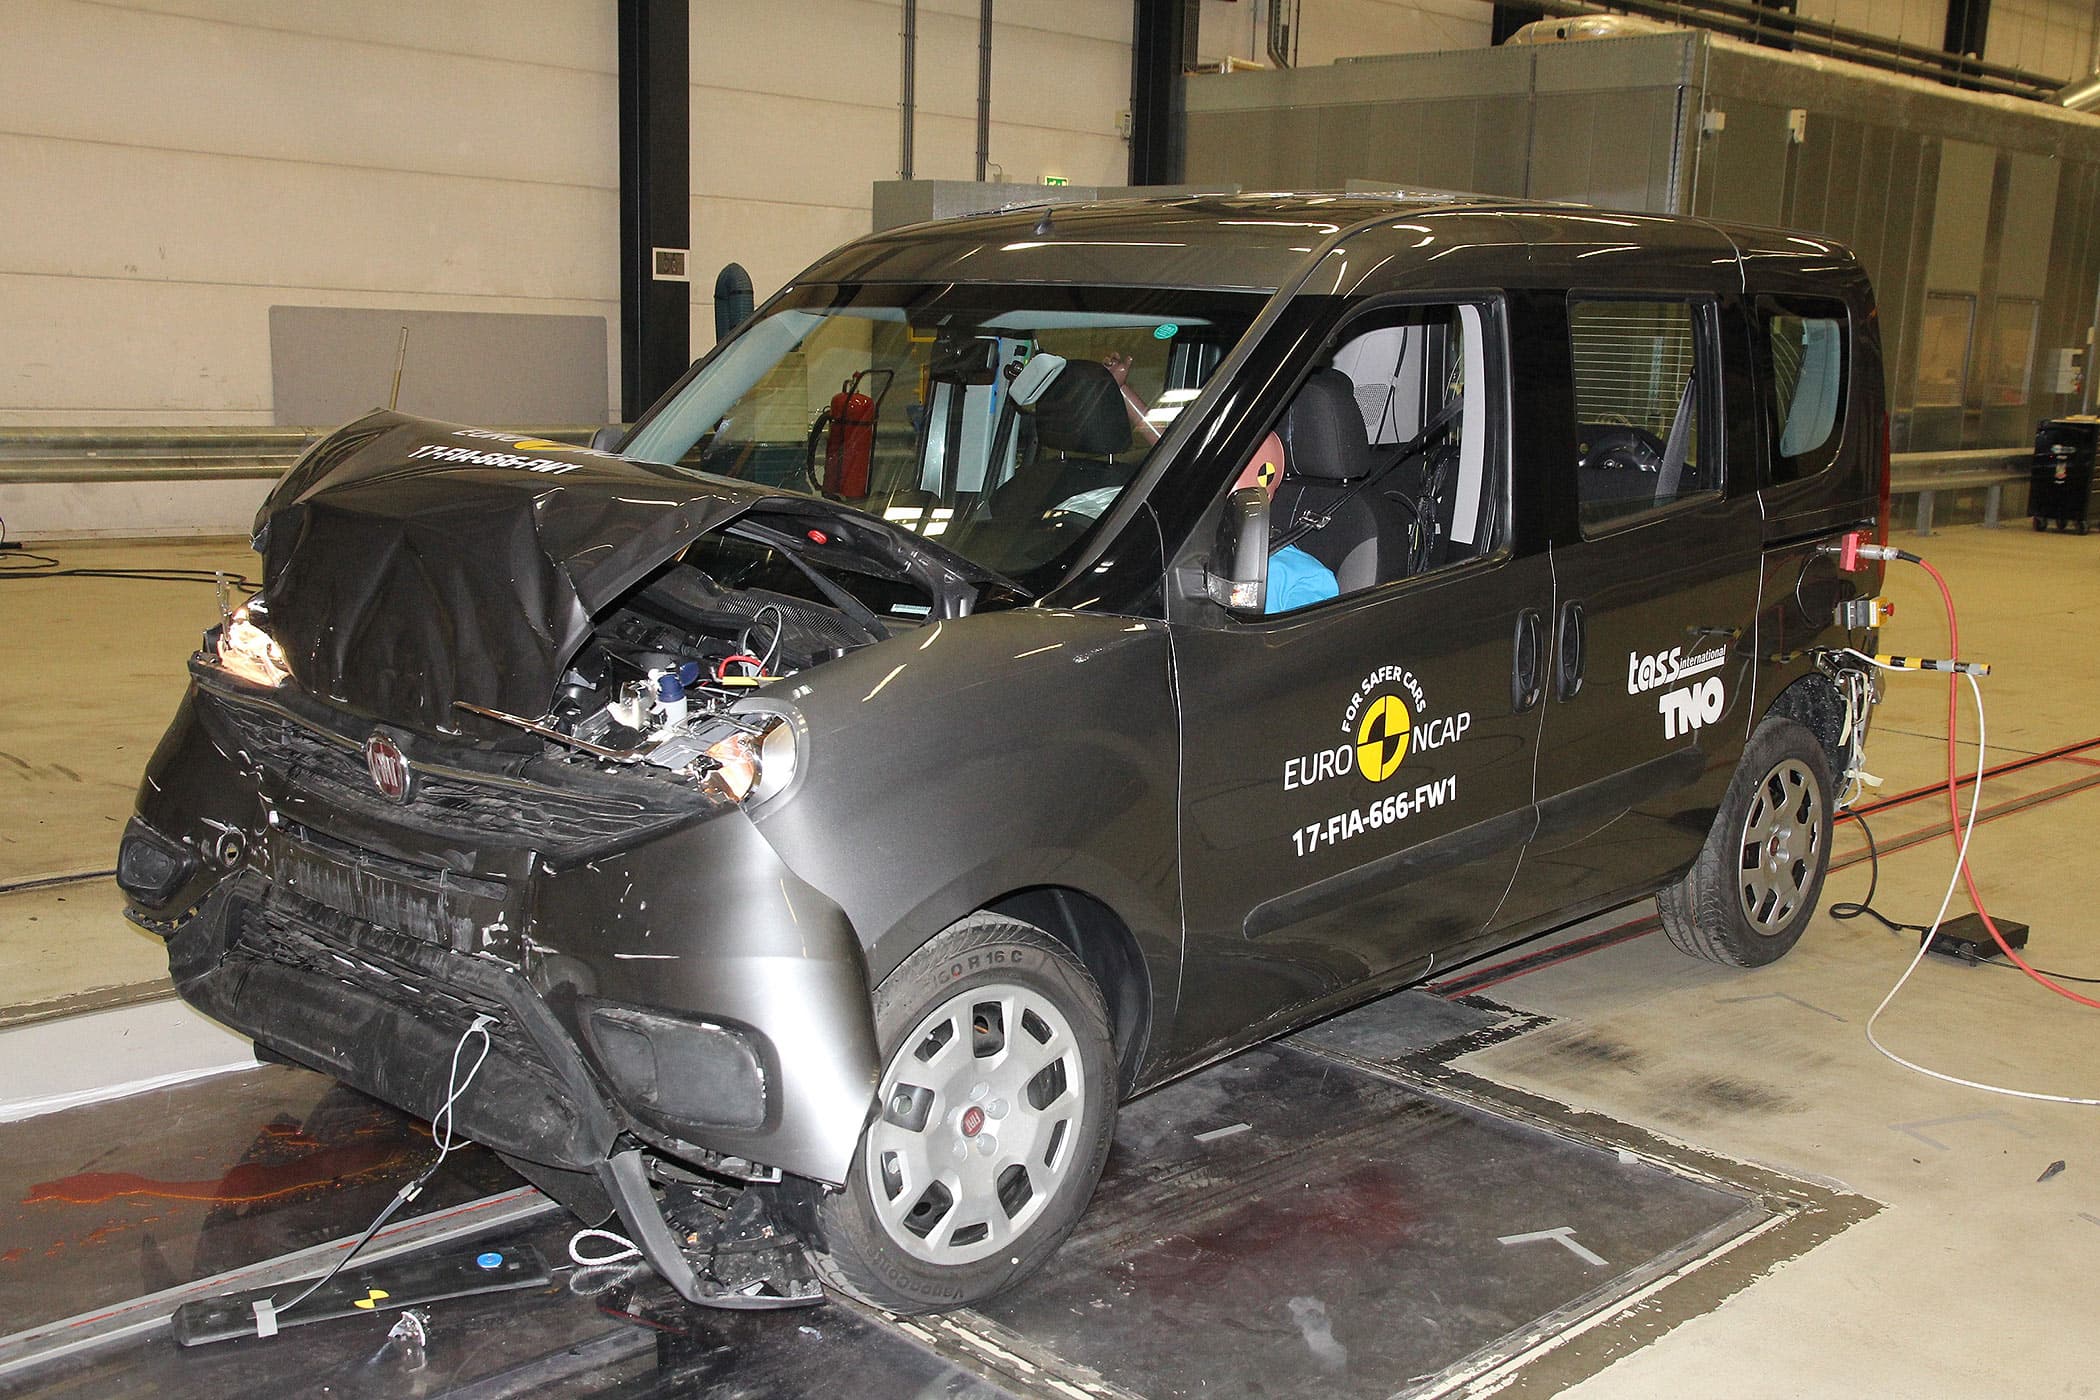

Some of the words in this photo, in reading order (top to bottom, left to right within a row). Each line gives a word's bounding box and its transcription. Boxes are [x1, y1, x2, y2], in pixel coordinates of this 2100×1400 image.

[408, 445, 583, 475] 17-FIA-666-FW1
[1341, 692, 1364, 733] FOR
[1361, 665, 1402, 695] SAFER
[1402, 671, 1427, 713] CARS
[1627, 646, 1681, 695] tass
[1680, 644, 1727, 669] international
[1659, 676, 1725, 740] TNO
[1284, 744, 1353, 791] EURO
[1412, 712, 1472, 754] NCAP
[1292, 775, 1457, 857] 17-FIA-666-FW1
[967, 955, 980, 970] R
[986, 950, 1005, 964] 16
[1010, 950, 1023, 963] C
